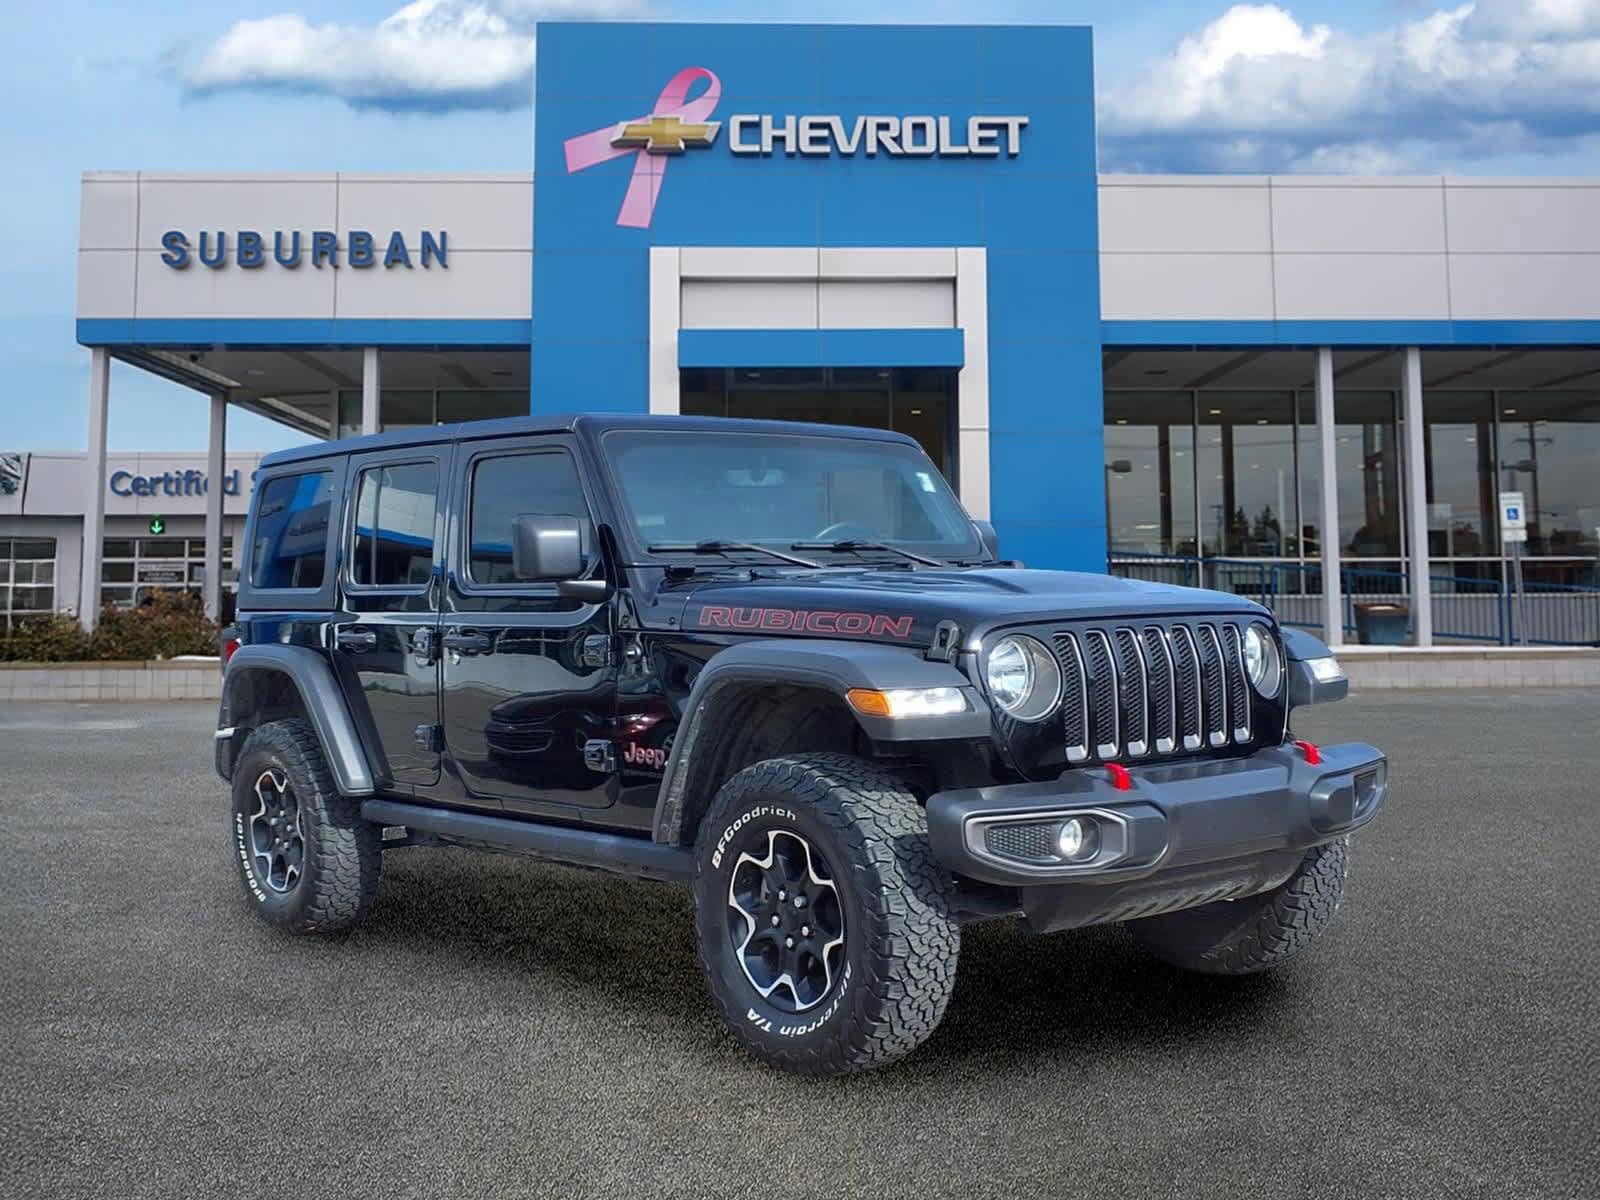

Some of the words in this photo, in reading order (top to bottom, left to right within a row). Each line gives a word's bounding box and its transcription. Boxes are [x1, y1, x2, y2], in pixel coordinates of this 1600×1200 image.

[729, 114, 1029, 156] CHEVROLET
[160, 230, 449, 269] SUBURBAN
[110, 469, 240, 497] Certifid
[698, 606, 913, 638] RUBICON
[624, 742, 666, 769] Jeep
[711, 804, 797, 869] BFGoodrich
[746, 1007, 772, 1034] T/A
